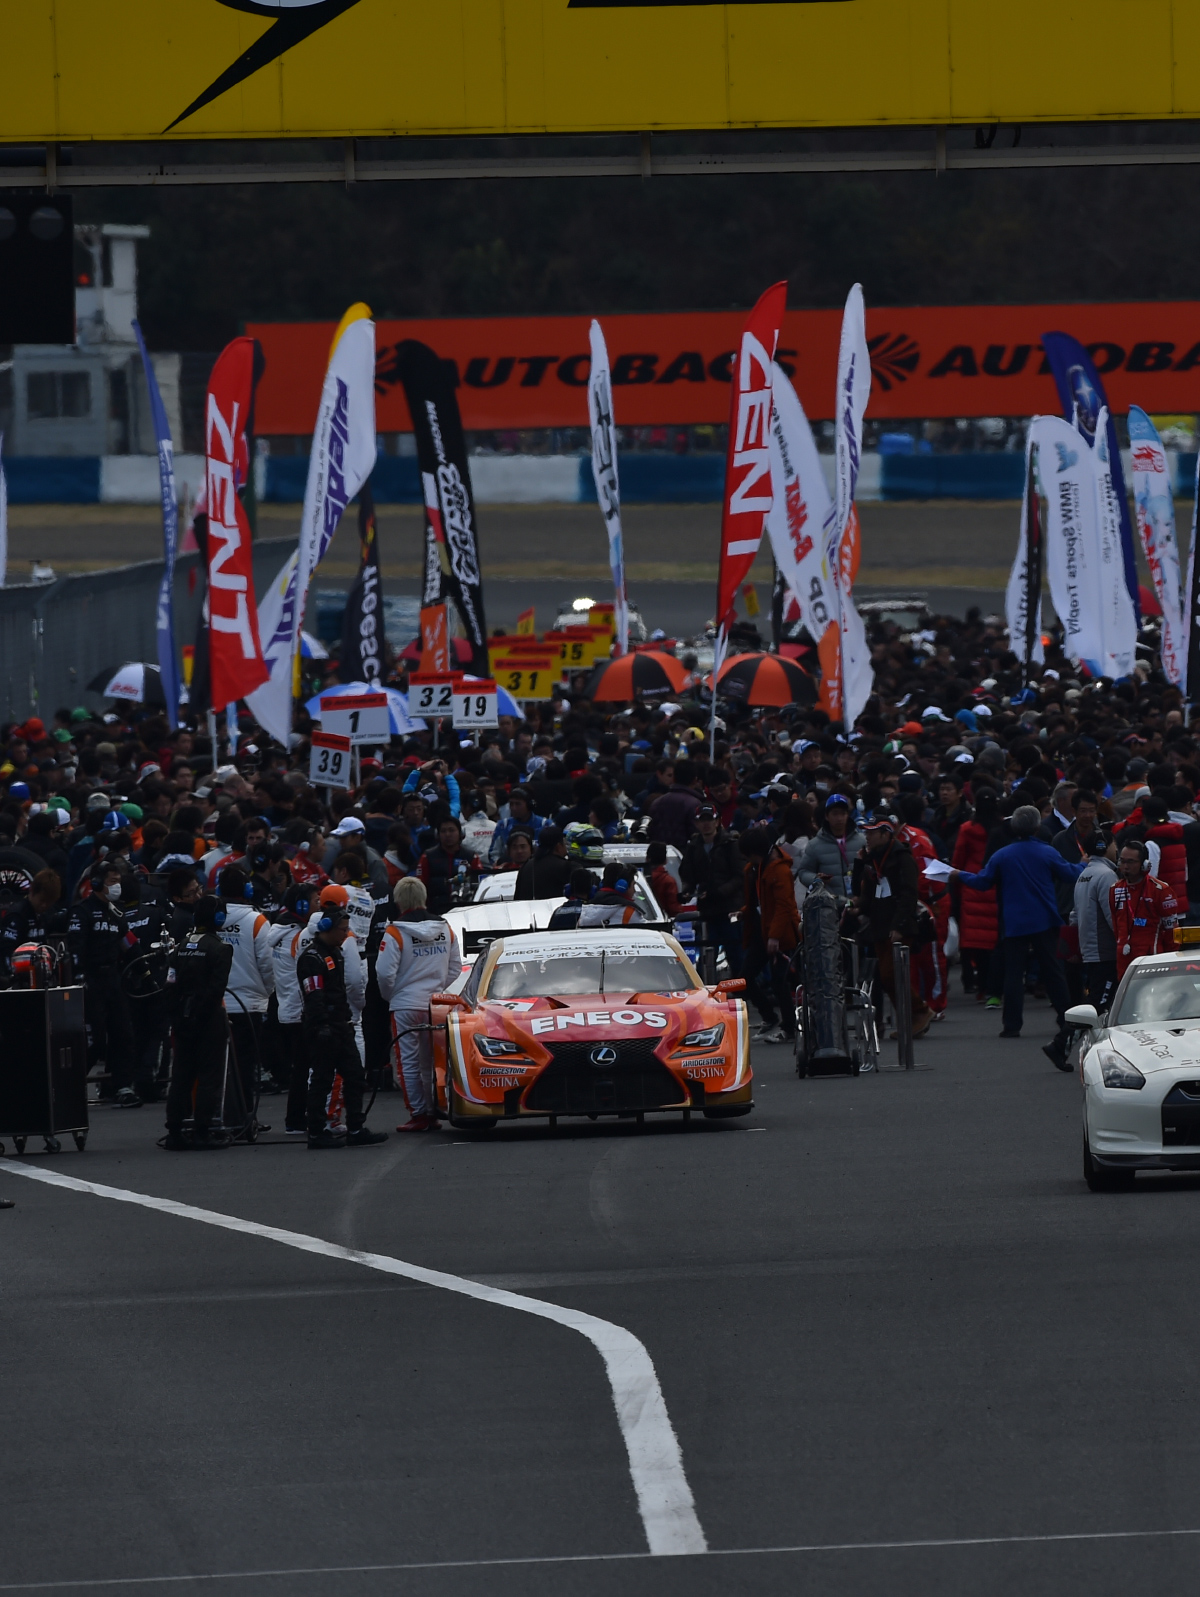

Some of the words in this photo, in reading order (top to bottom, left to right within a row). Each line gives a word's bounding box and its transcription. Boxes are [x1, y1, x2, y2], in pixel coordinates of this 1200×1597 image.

[206, 392, 257, 660] ZENT
[507, 671, 539, 690] 31
[420, 687, 452, 707] 32
[463, 696, 487, 716] 19
[349, 711, 359, 733] 1
[318, 750, 342, 775] 39
[413, 946, 448, 958] SUSTINA
[531, 1009, 668, 1036] ENEOS
[1155, 1044, 1174, 1060] Car
[479, 1066, 528, 1076] BRIDGESTONE
[681, 1056, 726, 1068] BRIDGESTONE
[480, 1076, 520, 1088] SUSTINA
[687, 1067, 725, 1079] SUSTINA
